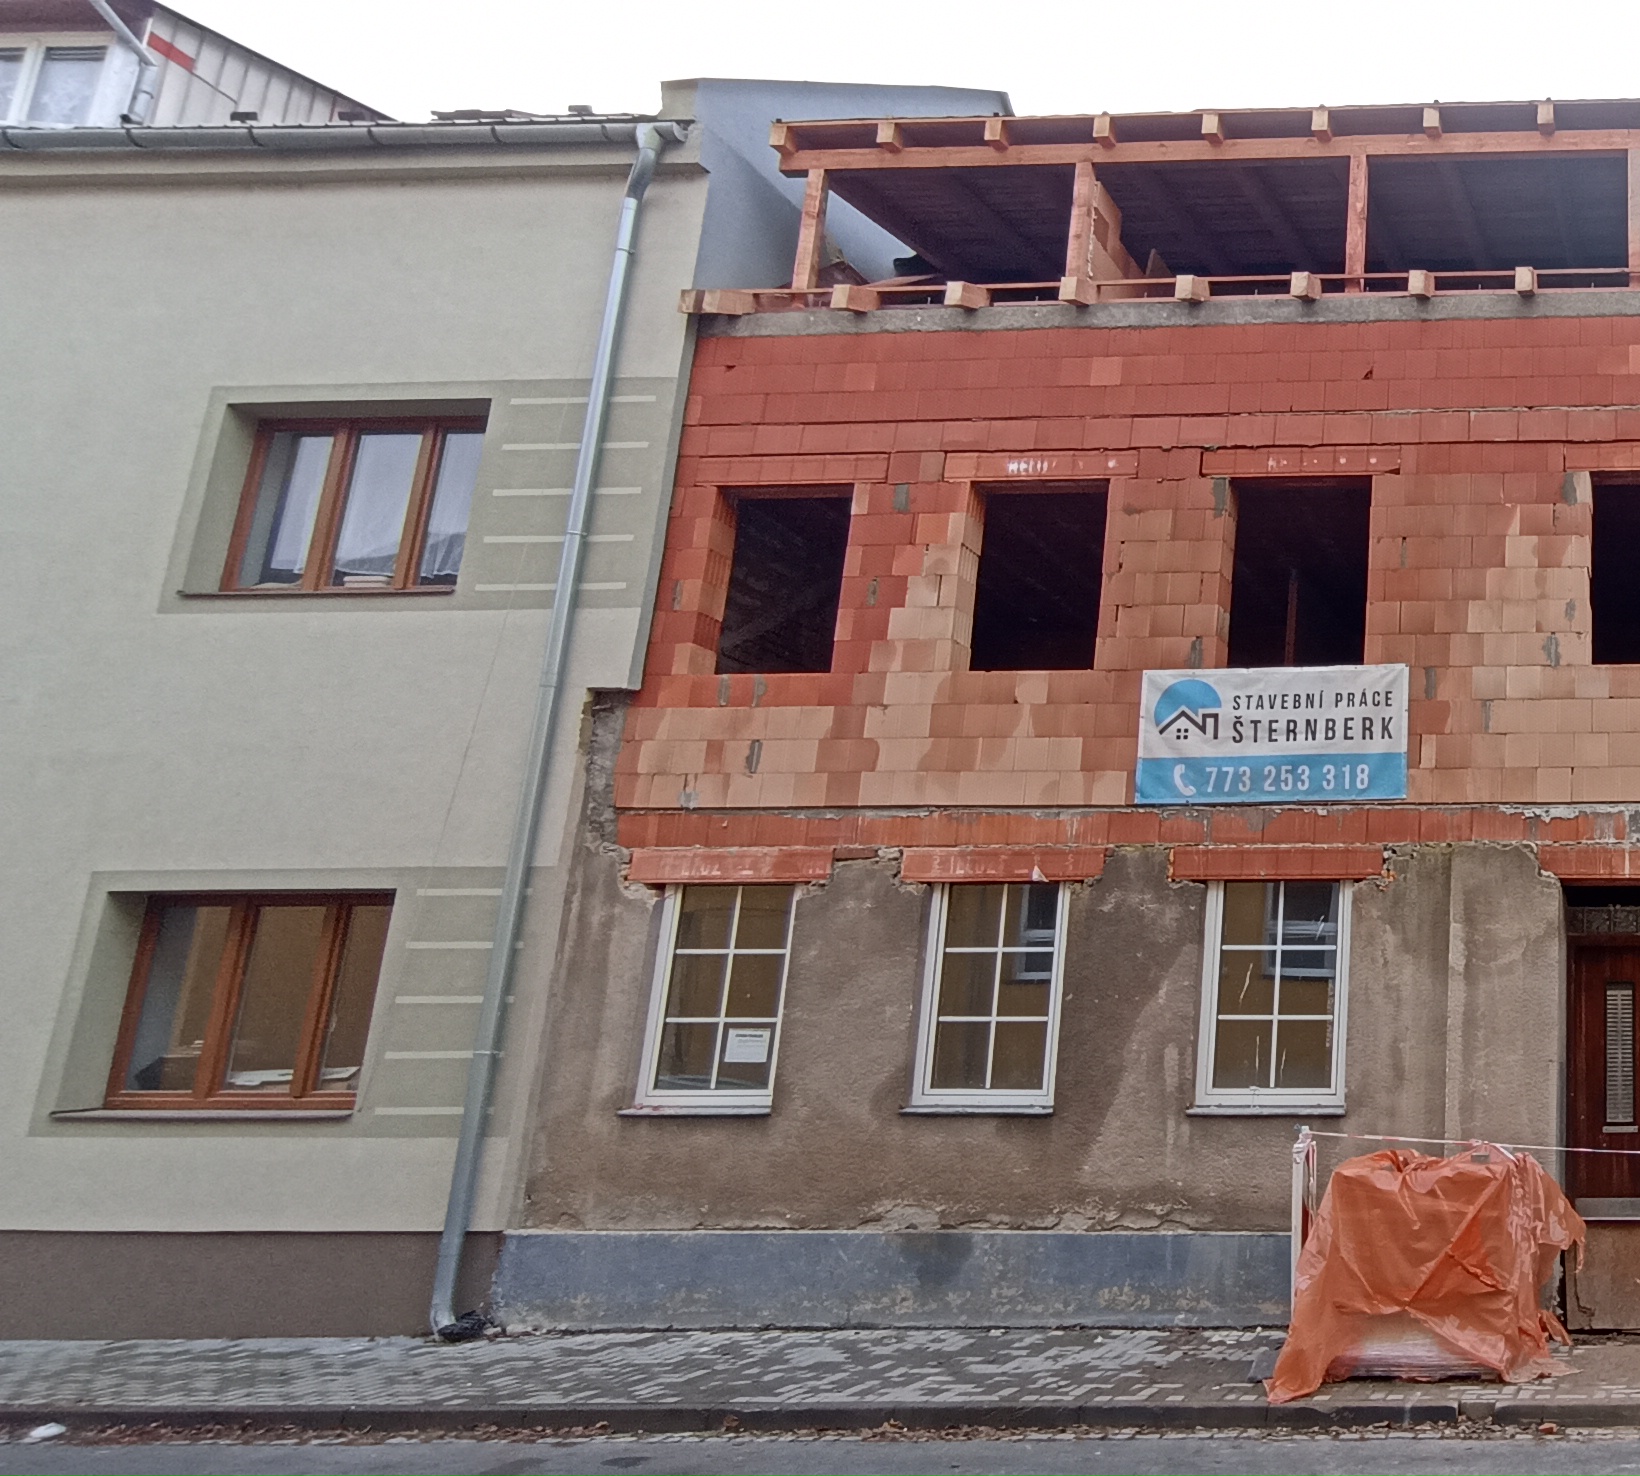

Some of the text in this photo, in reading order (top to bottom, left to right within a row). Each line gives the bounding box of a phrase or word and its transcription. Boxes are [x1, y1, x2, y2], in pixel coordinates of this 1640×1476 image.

[1232, 687, 1393, 711] STAVEBNÍ PRÁCE
[1231, 715, 1393, 744] ŠTERNBERK
[1205, 763, 1370, 793] 773 253 318
